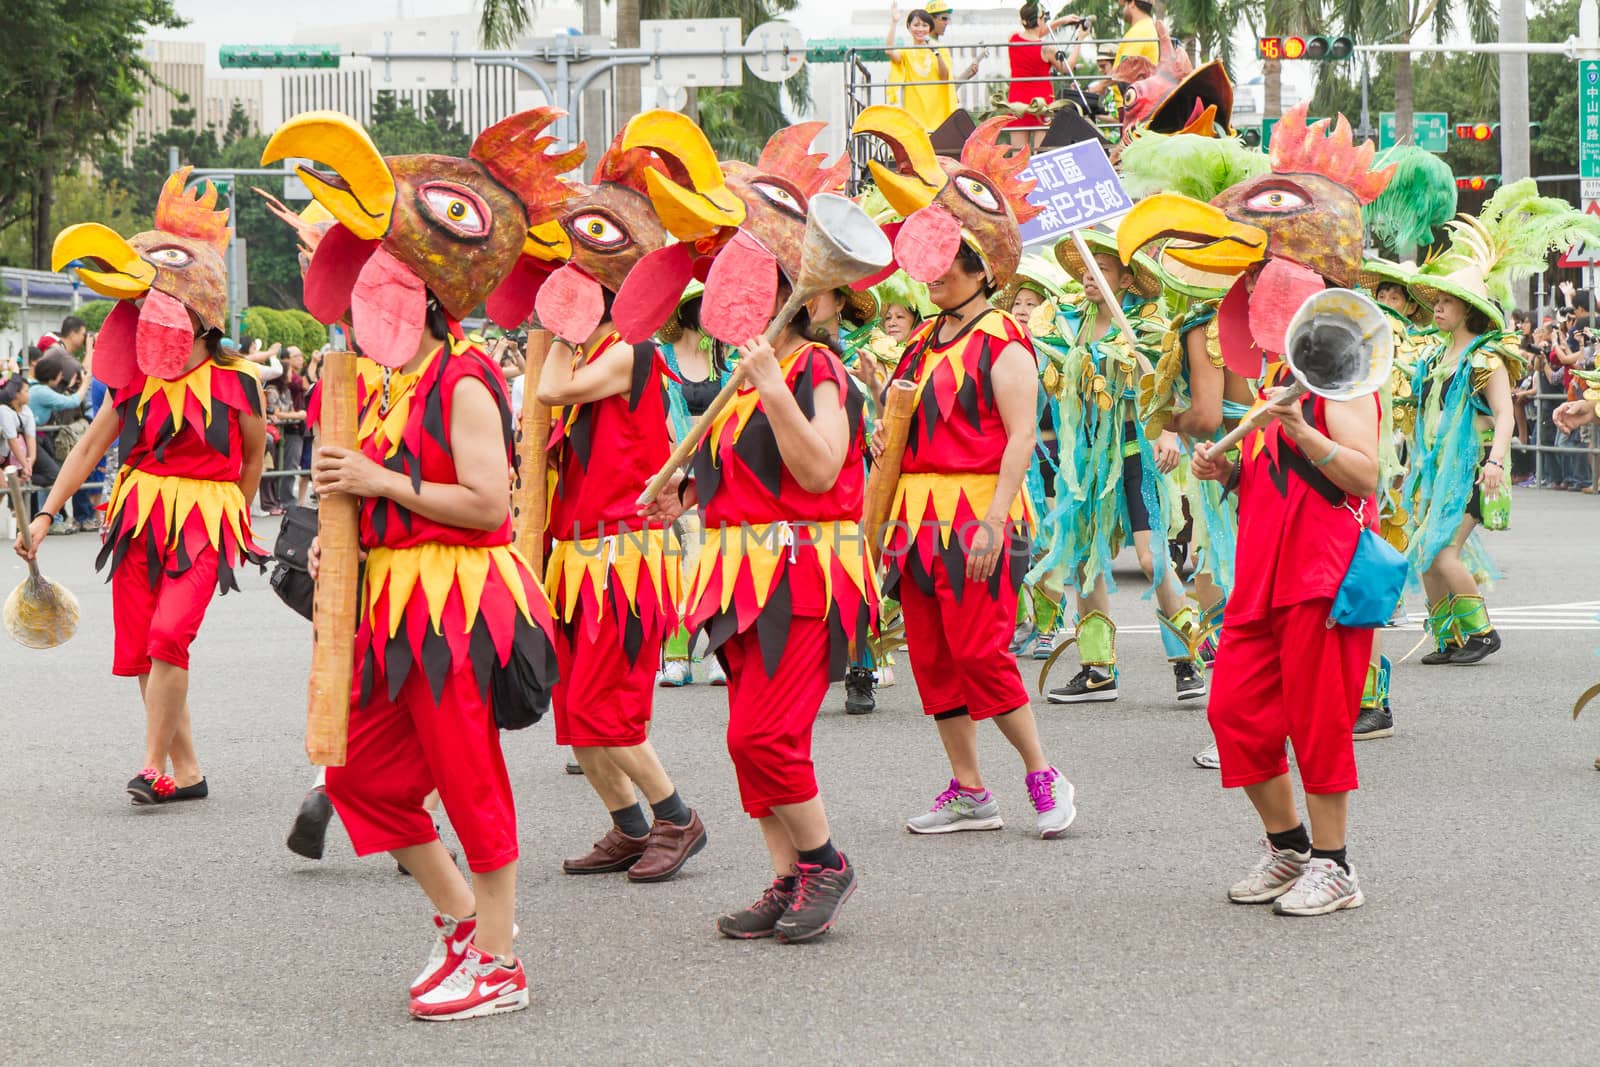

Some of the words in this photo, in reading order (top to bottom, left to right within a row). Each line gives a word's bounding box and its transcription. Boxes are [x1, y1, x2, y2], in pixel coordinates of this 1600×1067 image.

[1260, 39, 1278, 59] 46
[1586, 86, 1599, 140] 中山南路
